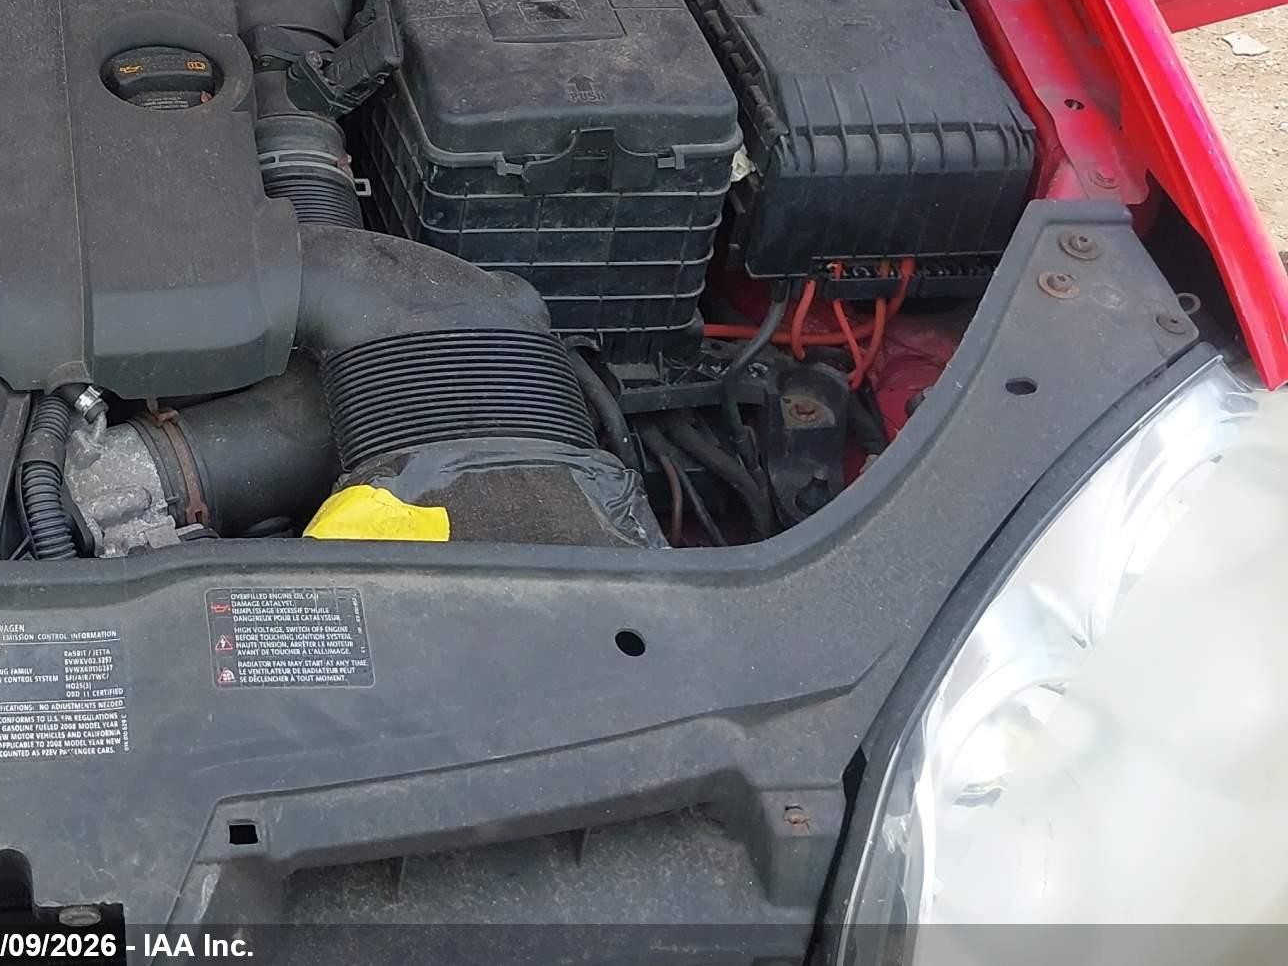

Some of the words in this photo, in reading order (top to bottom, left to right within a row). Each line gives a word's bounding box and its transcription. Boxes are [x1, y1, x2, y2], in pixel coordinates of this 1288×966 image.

[70, 630, 116, 639] INFORMATION
[93, 648, 110, 656] JETTA
[238, 660, 271, 668] RADIATOR
[66, 690, 80, 698] OBD
[92, 688, 124, 696] CERTIFIED
[52, 702, 96, 710] ADJUSTMENTS
[98, 700, 124, 708] NEEDED
[74, 712, 118, 721] REGULATIONS
[2, 724, 34, 732] GASOLINE
[78, 722, 100, 730] MODEL
[102, 720, 118, 728] YEAR
[11, 732, 34, 740] MOTOR
[83, 730, 120, 738] CALIFORNIA
[36, 740, 44, 748] TO
[88, 738, 104, 746] YEAR
[0, 750, 30, 758] COUNTED
